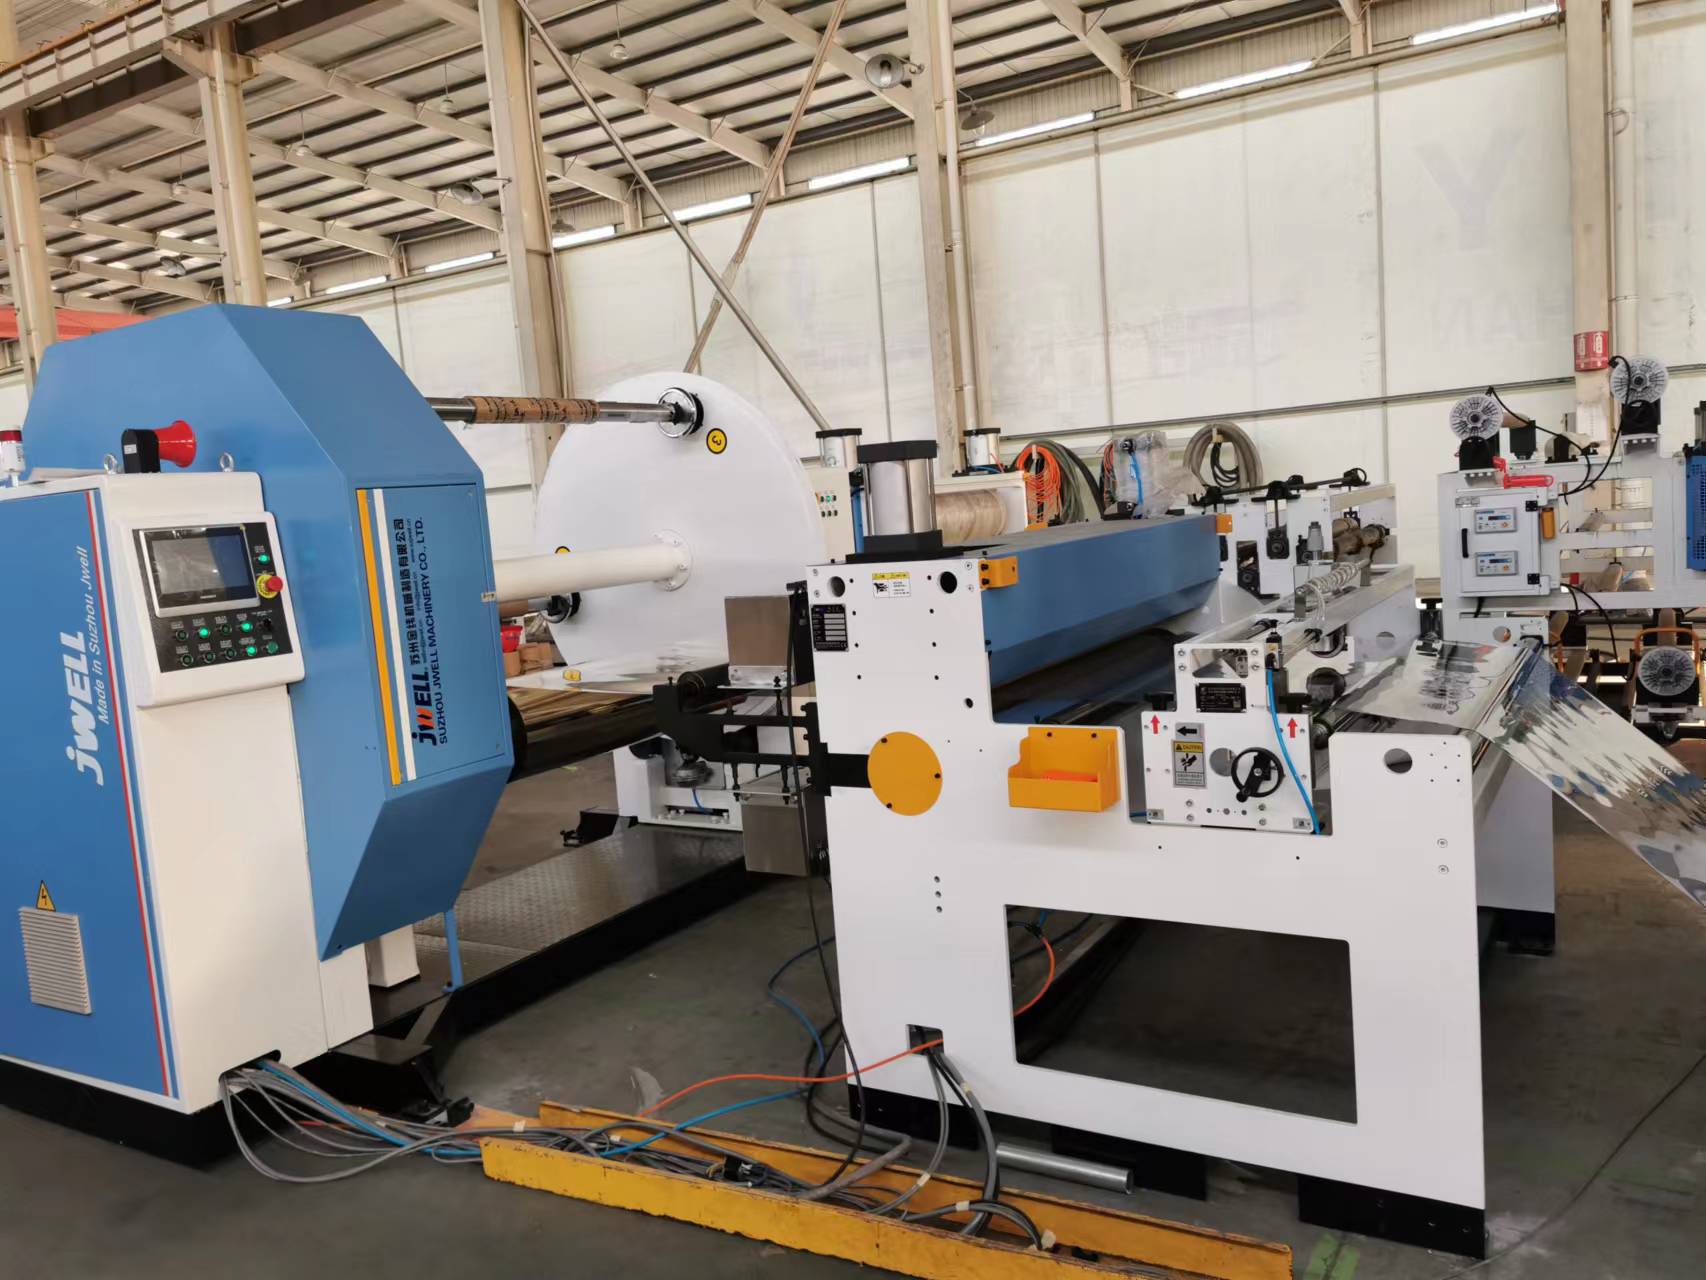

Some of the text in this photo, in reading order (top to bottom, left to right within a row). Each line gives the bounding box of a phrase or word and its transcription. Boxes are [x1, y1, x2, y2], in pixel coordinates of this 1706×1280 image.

[415, 517, 425, 543] LTD.
[76, 546, 109, 724] Made in Suzhou Jwell
[420, 573, 437, 647] MACHINERY
[430, 650, 441, 689] JWELL
[434, 692, 448, 744] SUZHOU
